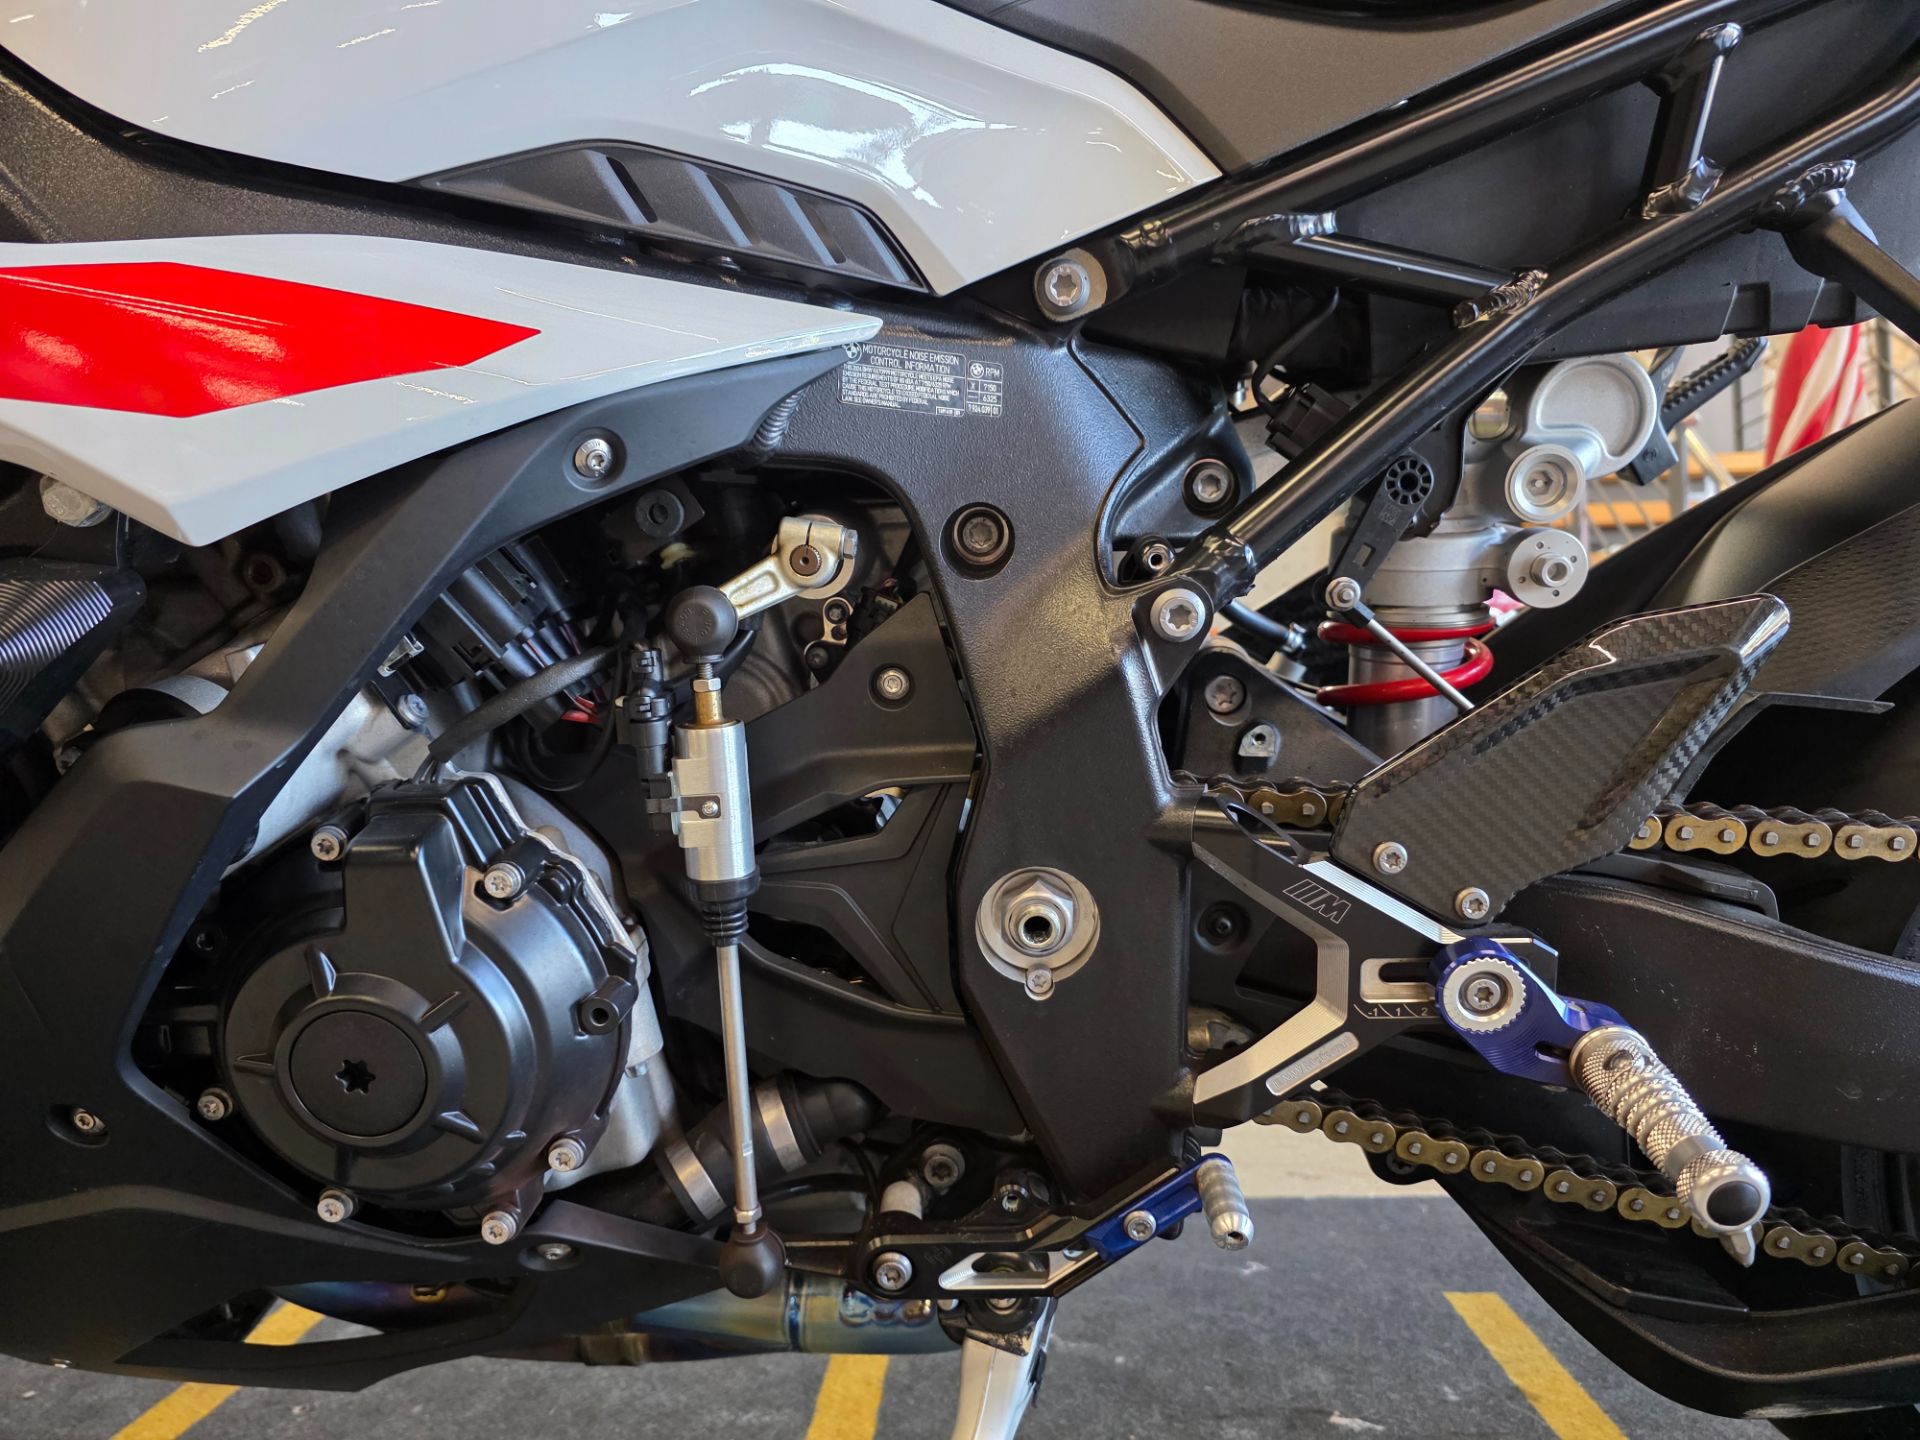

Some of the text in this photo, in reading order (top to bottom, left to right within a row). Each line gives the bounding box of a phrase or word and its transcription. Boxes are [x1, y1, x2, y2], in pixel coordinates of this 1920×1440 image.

[863, 346, 959, 365] MOTORCYCLE NOISE EMISSION
[870, 356, 902, 369] CONTROL
[905, 360, 950, 374] INFORMATION
[986, 367, 1000, 379] RPM
[1421, 1008, 1428, 1016] 2
